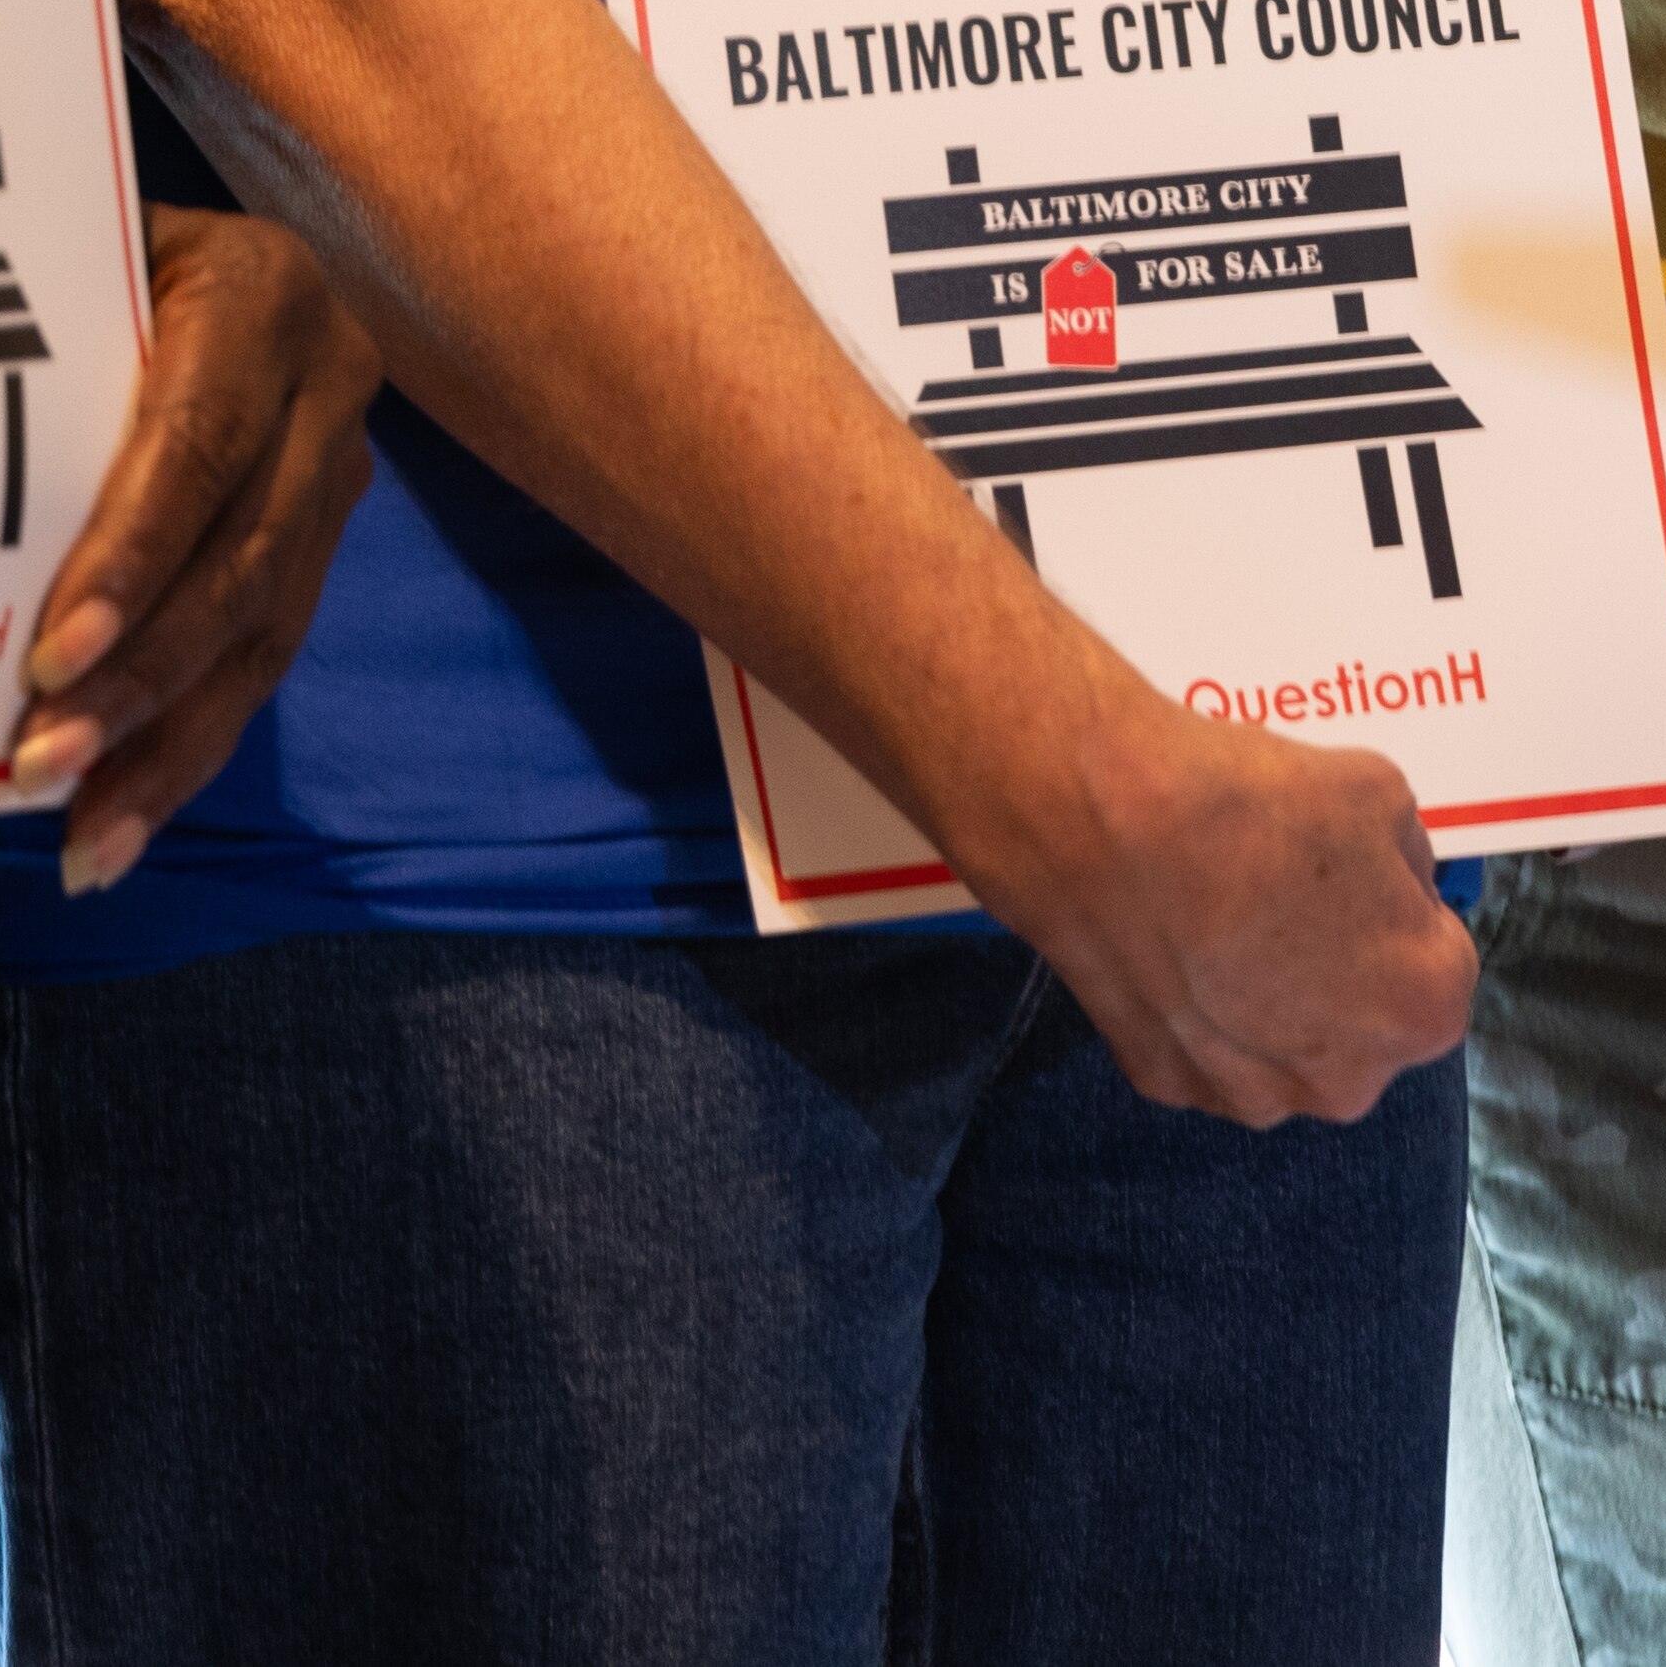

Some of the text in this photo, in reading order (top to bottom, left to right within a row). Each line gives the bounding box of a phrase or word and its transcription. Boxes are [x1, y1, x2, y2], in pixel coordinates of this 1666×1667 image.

[725, 9, 1082, 106] BALTIMORE
[982, 173, 1312, 232] BALTIMORE CITY
[992, 244, 1322, 305] IS FOR SALE
[1049, 305, 1112, 334] NOT
